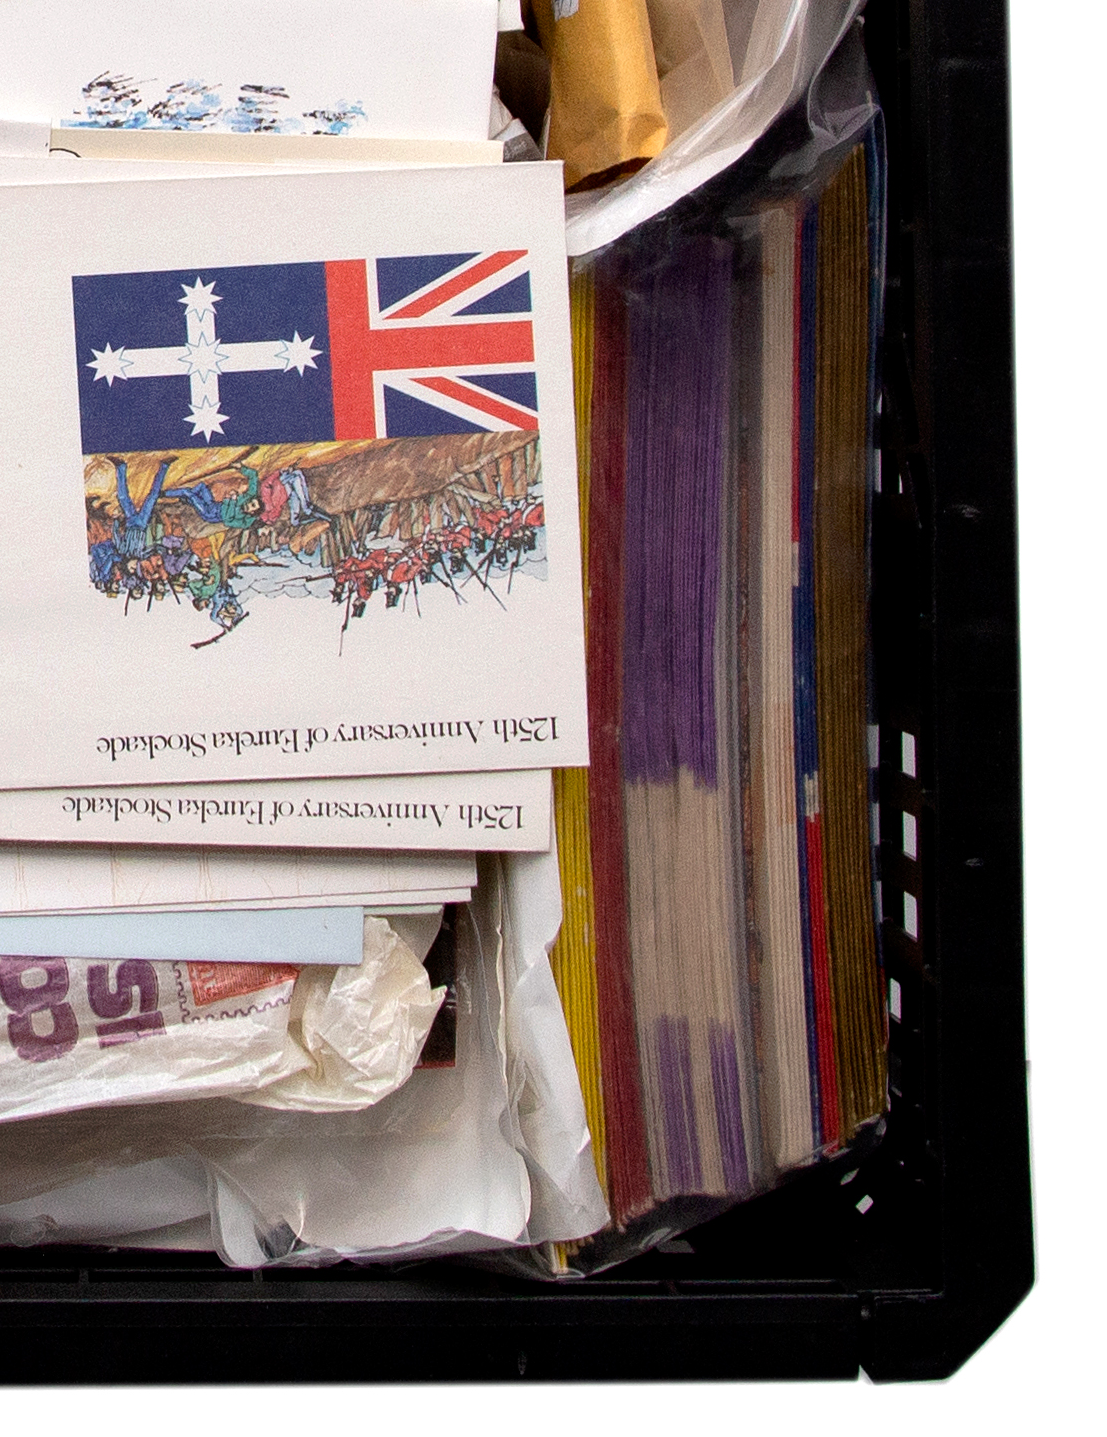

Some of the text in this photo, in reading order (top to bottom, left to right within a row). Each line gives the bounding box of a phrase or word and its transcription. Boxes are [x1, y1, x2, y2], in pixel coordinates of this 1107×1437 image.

[96, 716, 560, 762] 125th Anniversary of Eureka Stockade
[62, 796, 525, 830] 125th Anniversary of Eureka Stockade
